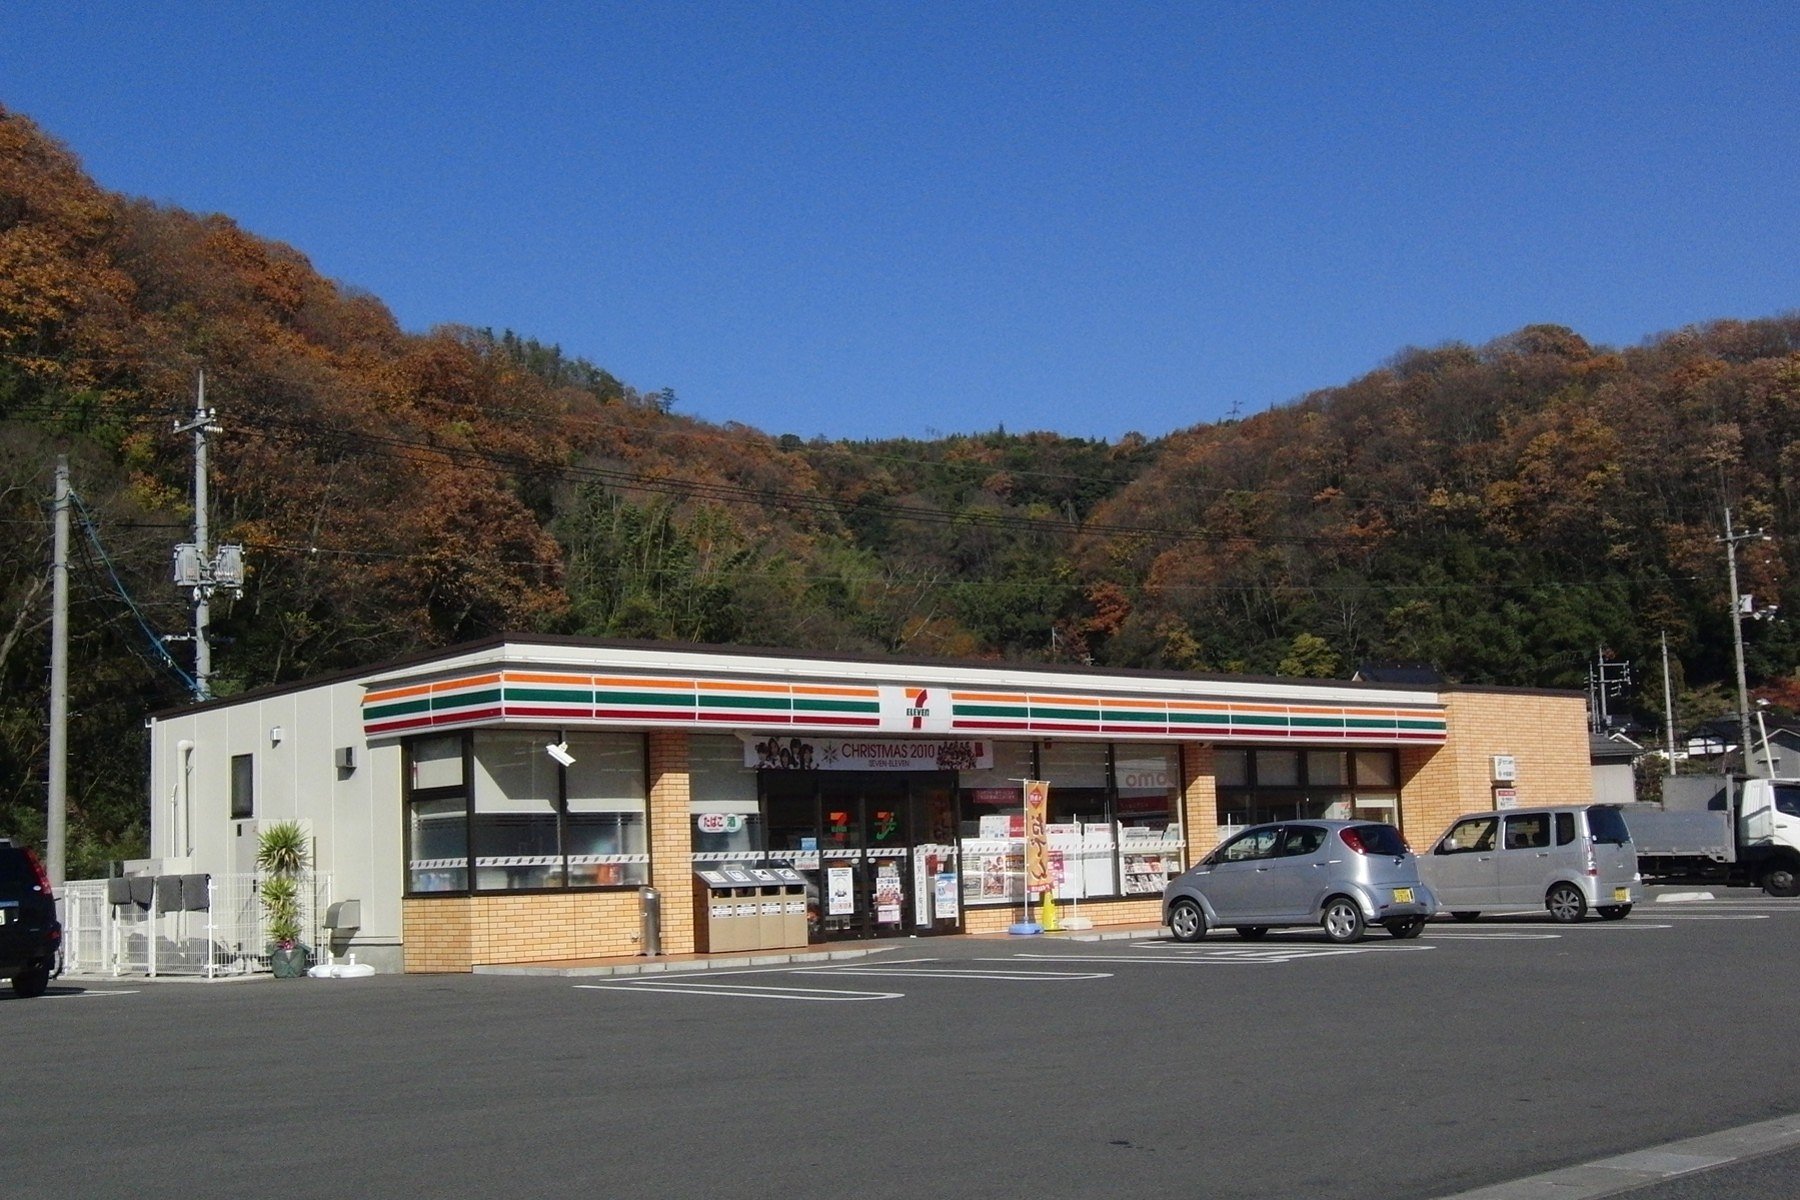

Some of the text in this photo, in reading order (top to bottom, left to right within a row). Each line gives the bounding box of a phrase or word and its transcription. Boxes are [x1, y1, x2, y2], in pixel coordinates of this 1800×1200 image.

[841, 743, 935, 759] CHRISTMAS 2010
[703, 815, 736, 828] たばこ 酒
